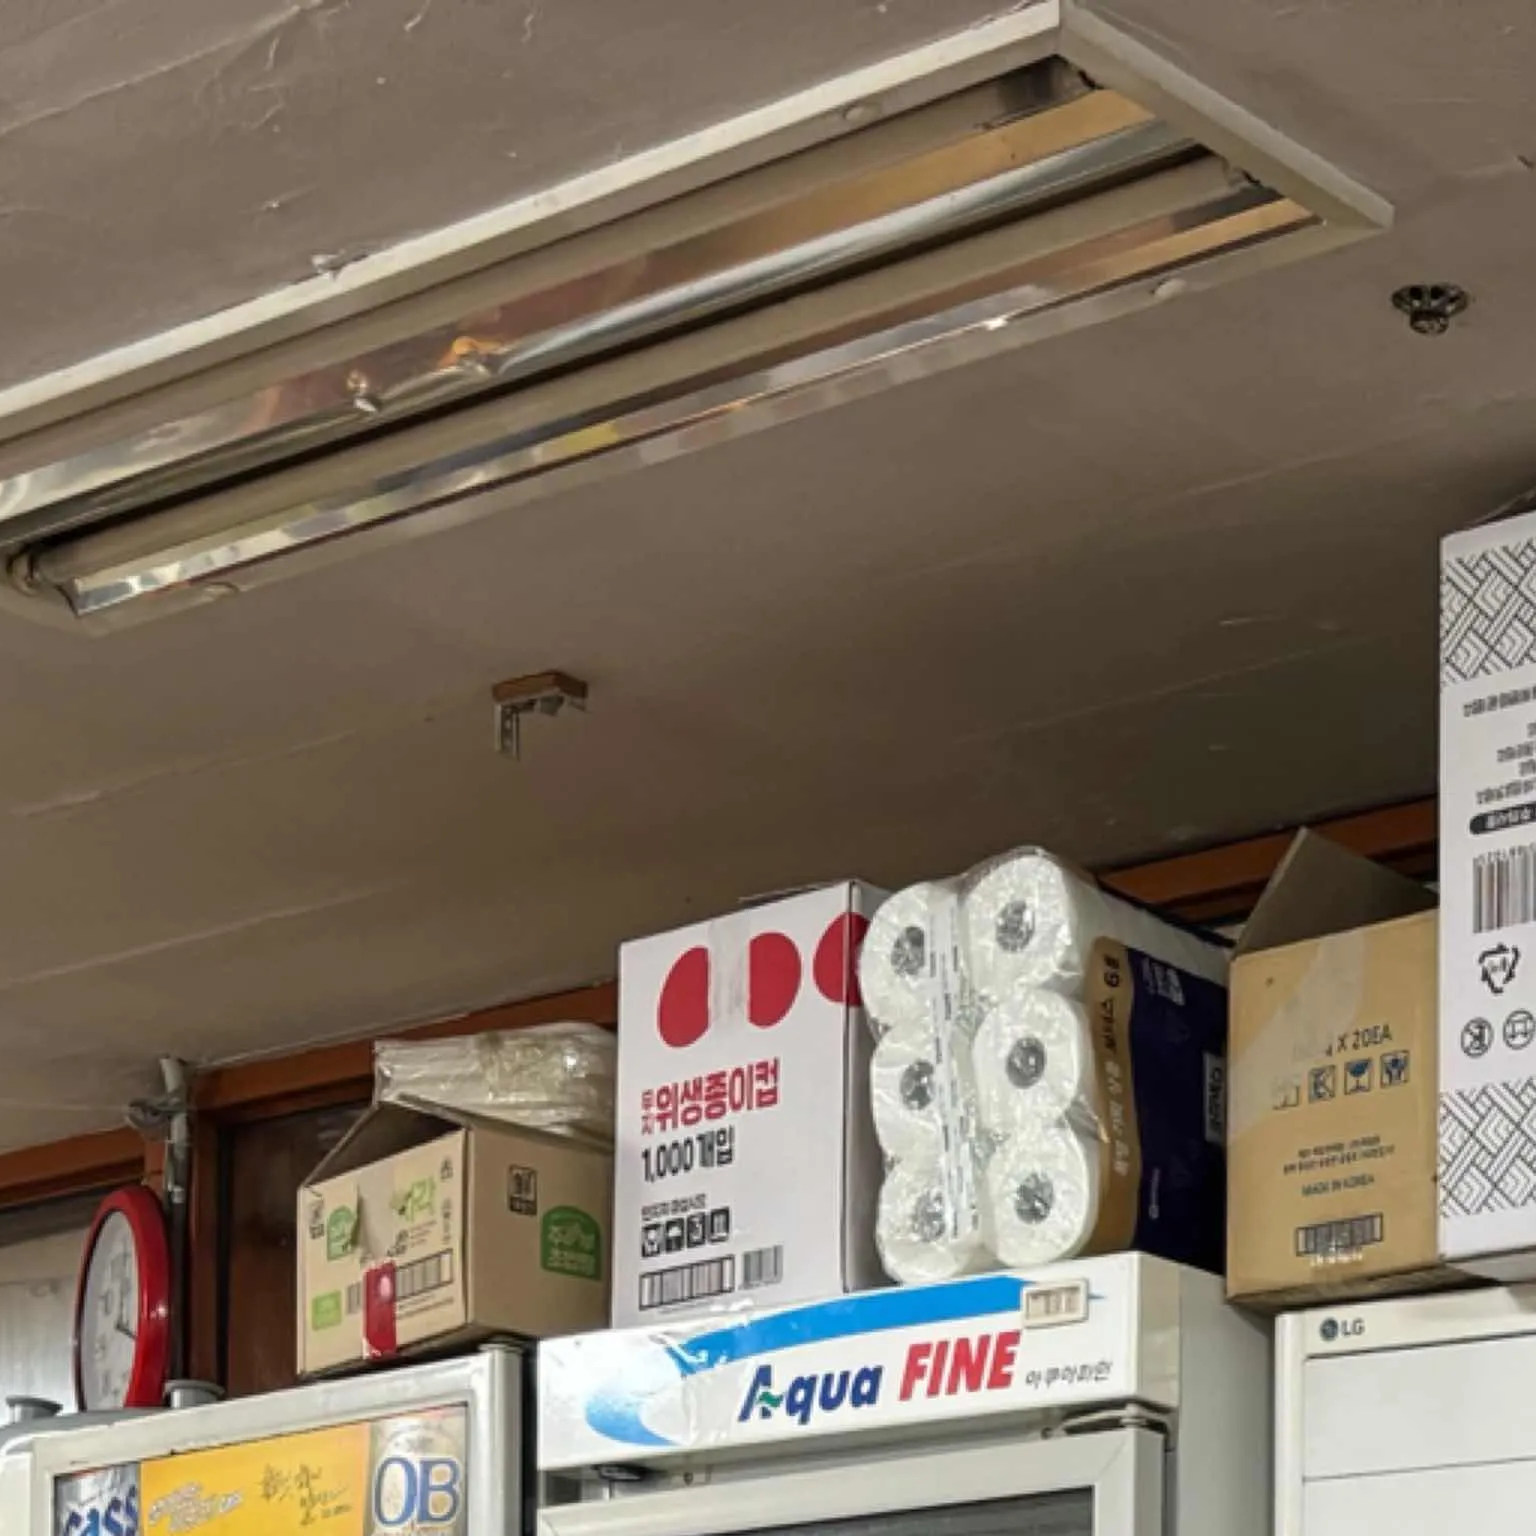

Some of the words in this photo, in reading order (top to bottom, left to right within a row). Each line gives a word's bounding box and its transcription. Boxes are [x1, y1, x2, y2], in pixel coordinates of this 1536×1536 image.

[656, 1055, 781, 1135] 위생종이컵
[1341, 1317, 1367, 1338] LG
[738, 1365, 884, 1428] Aqua
[898, 1330, 1023, 1403] FINE
[1024, 1359, 1115, 1392] 아쿠아파인
[372, 1455, 462, 1527] OB
